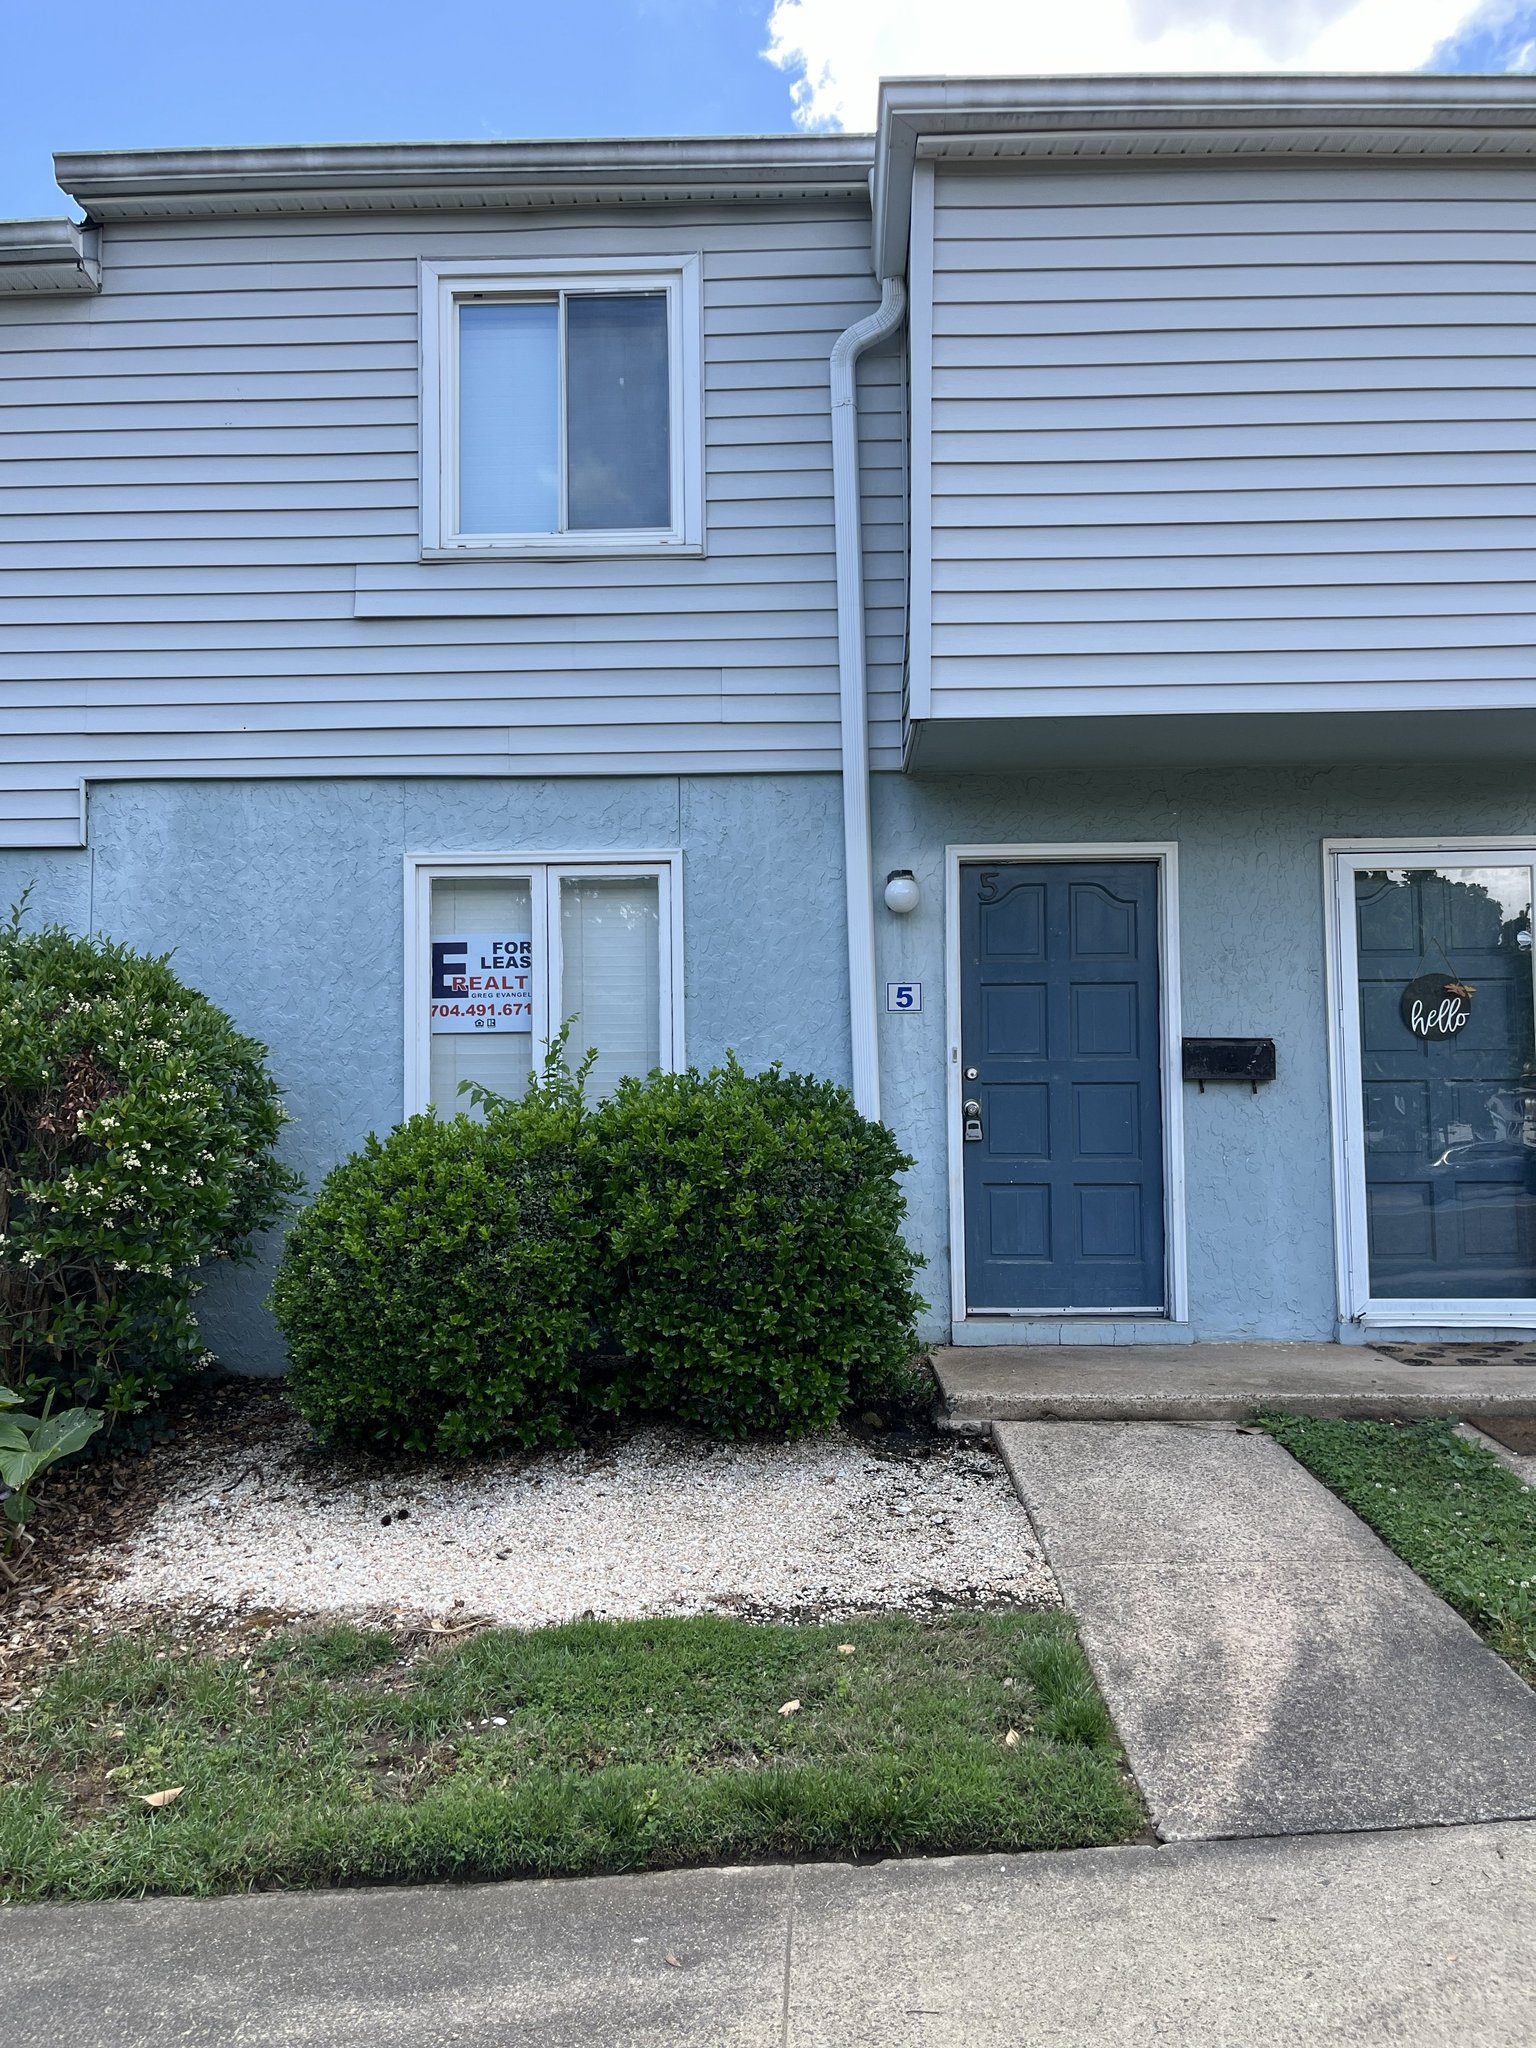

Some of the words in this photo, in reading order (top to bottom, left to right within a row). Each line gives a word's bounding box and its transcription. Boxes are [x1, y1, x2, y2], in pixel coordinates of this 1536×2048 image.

[977, 872, 1000, 902] 5
[492, 941, 532, 955] FOR
[431, 942, 469, 999] E
[481, 955, 532, 969] LEAS
[452, 975, 529, 991] REALT
[896, 986, 914, 1008] 5
[431, 1003, 532, 1017] 704.491.671
[1411, 997, 1471, 1036] hello
